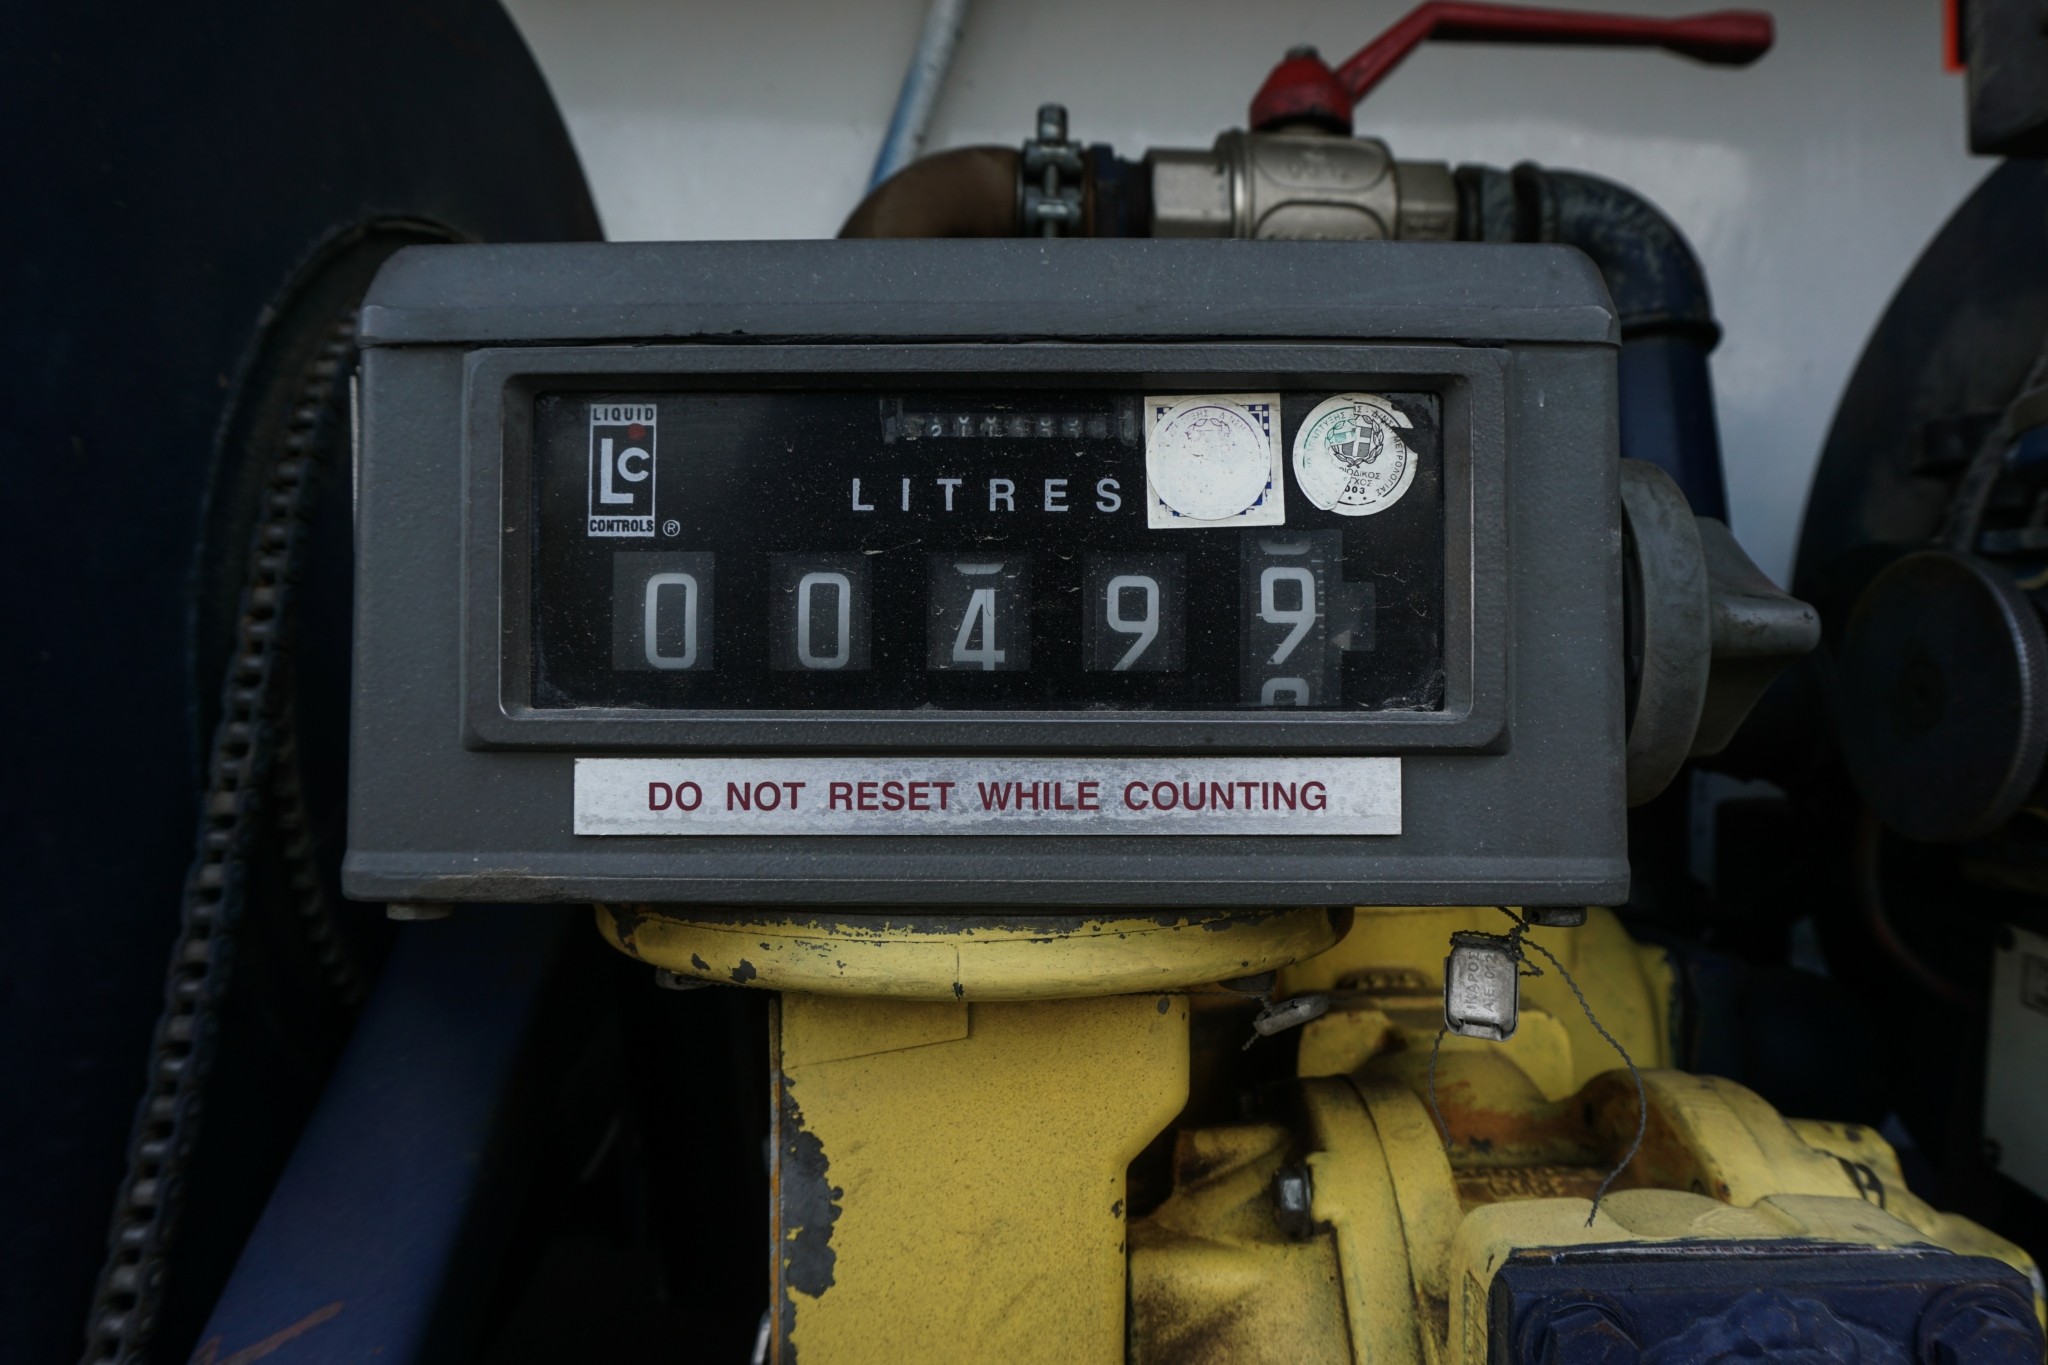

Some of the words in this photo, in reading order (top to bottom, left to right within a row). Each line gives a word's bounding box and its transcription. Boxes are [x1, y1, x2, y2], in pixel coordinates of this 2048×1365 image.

[592, 407, 654, 421] LIQUID
[851, 478, 1122, 513] LITRES
[589, 519, 654, 532] CONTROLS
[648, 781, 703, 811] DO
[726, 781, 806, 811] NOT
[829, 781, 956, 811] RESET
[977, 781, 1100, 811] WHILE
[1123, 780, 1328, 811] COUNTING
